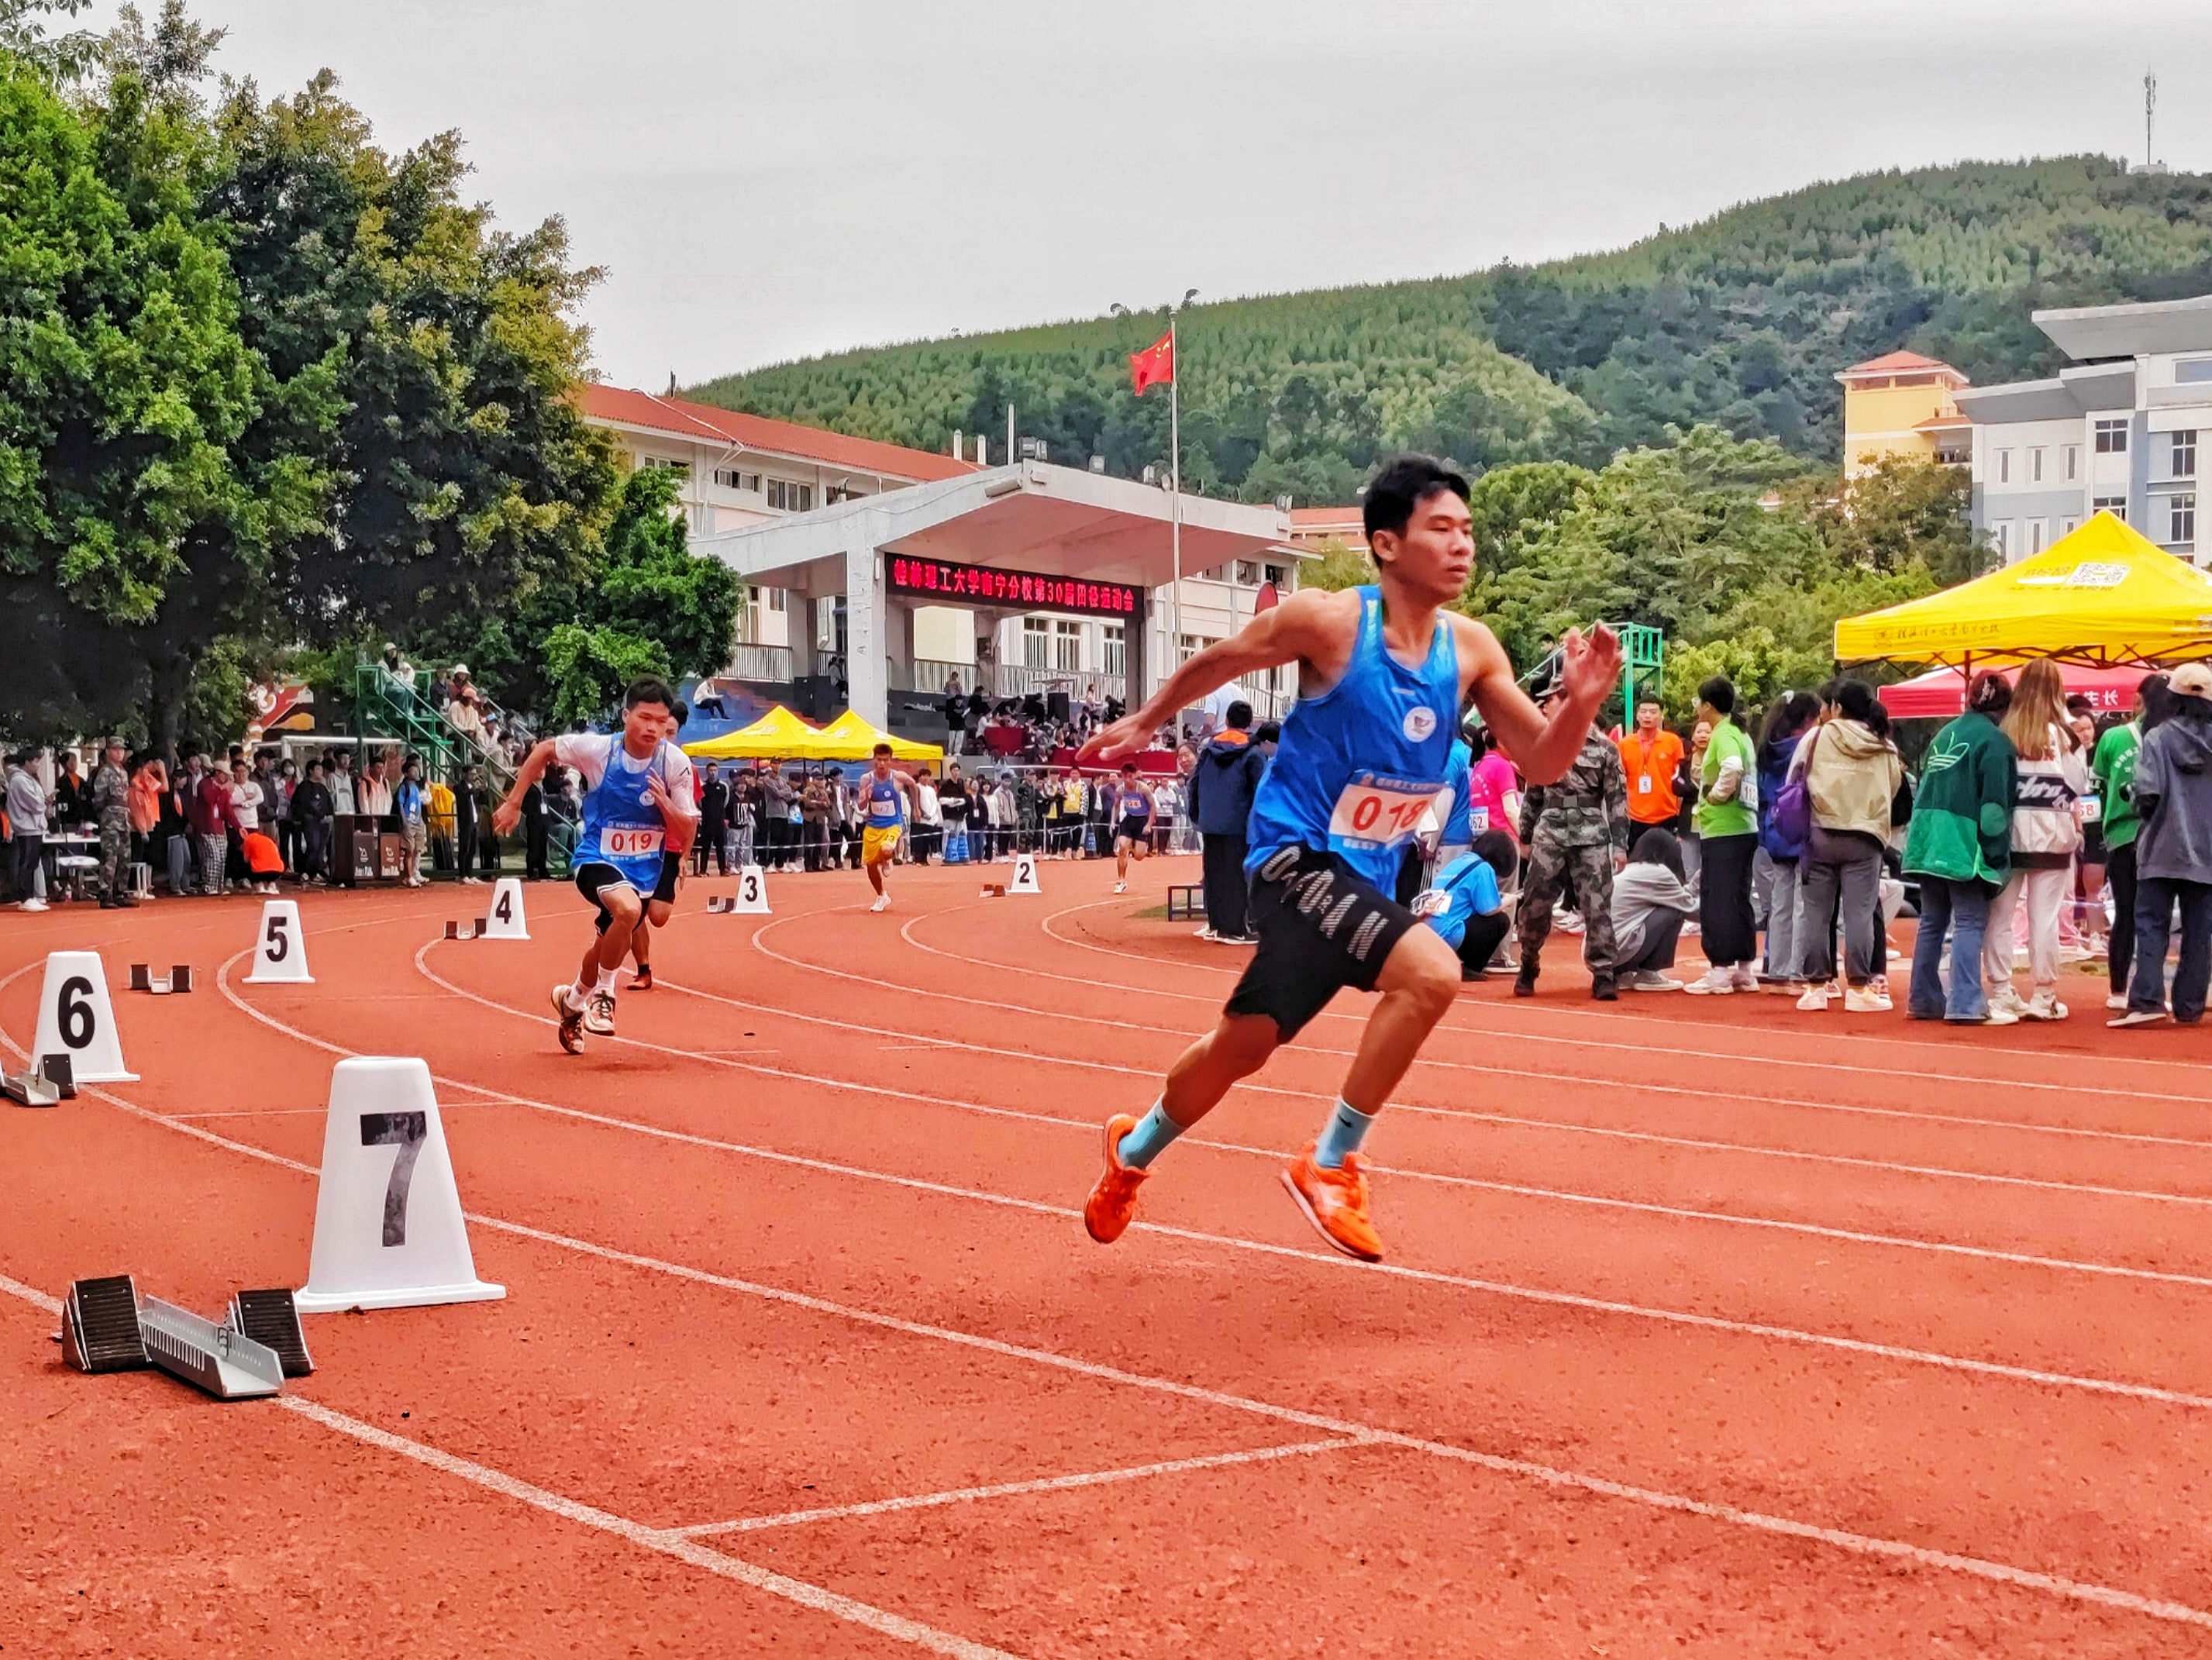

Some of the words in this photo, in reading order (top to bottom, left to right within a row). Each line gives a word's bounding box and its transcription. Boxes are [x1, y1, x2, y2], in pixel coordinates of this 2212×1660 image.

[1352, 795, 1429, 835] 018
[611, 832, 653, 852] 019
[745, 875, 758, 902] 3
[1018, 862, 1030, 883] 2
[494, 890, 512, 925] 4
[265, 916, 288, 962] 5
[57, 976, 95, 1049] 6
[359, 1110, 428, 1247] 7
